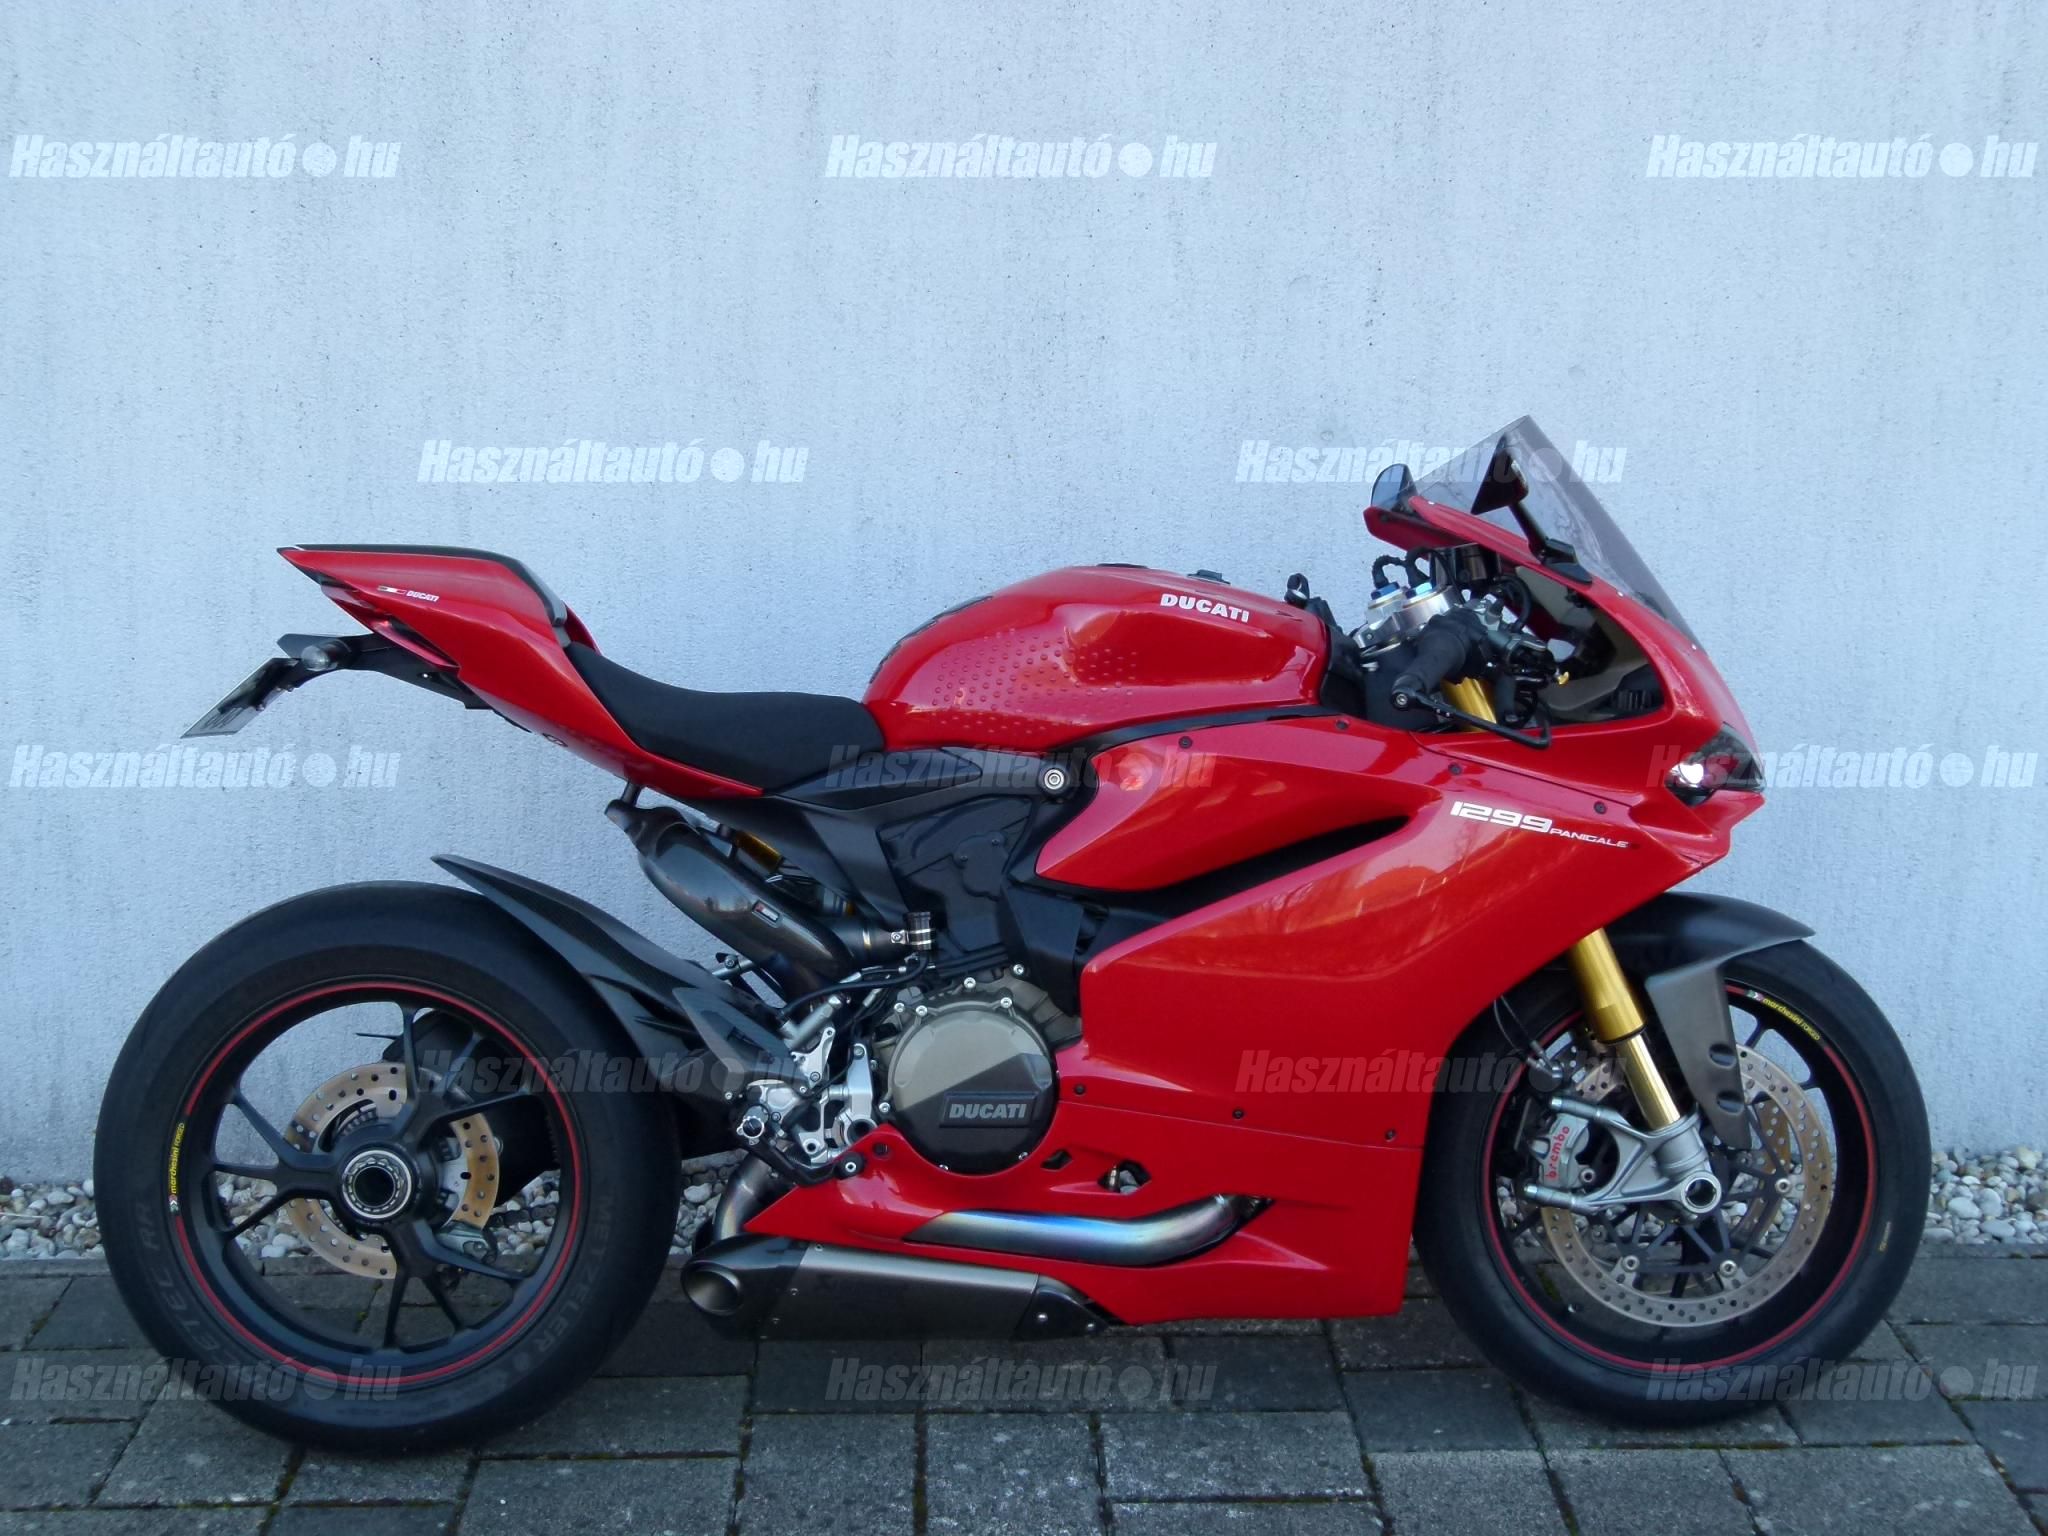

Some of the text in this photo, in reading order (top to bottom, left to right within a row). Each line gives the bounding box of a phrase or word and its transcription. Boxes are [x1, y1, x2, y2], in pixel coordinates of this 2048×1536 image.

[406, 590, 440, 602] DUCATI
[1160, 593, 1250, 623] DUCATI
[1450, 801, 1629, 848] 1299 PANIGALE
[1762, 998, 1803, 1025] marchesini
[949, 1103, 1027, 1119] DUCATI
[169, 1146, 179, 1194] marchesini
[1544, 1126, 1570, 1179] brembo
[535, 1197, 614, 1353] METZELER
